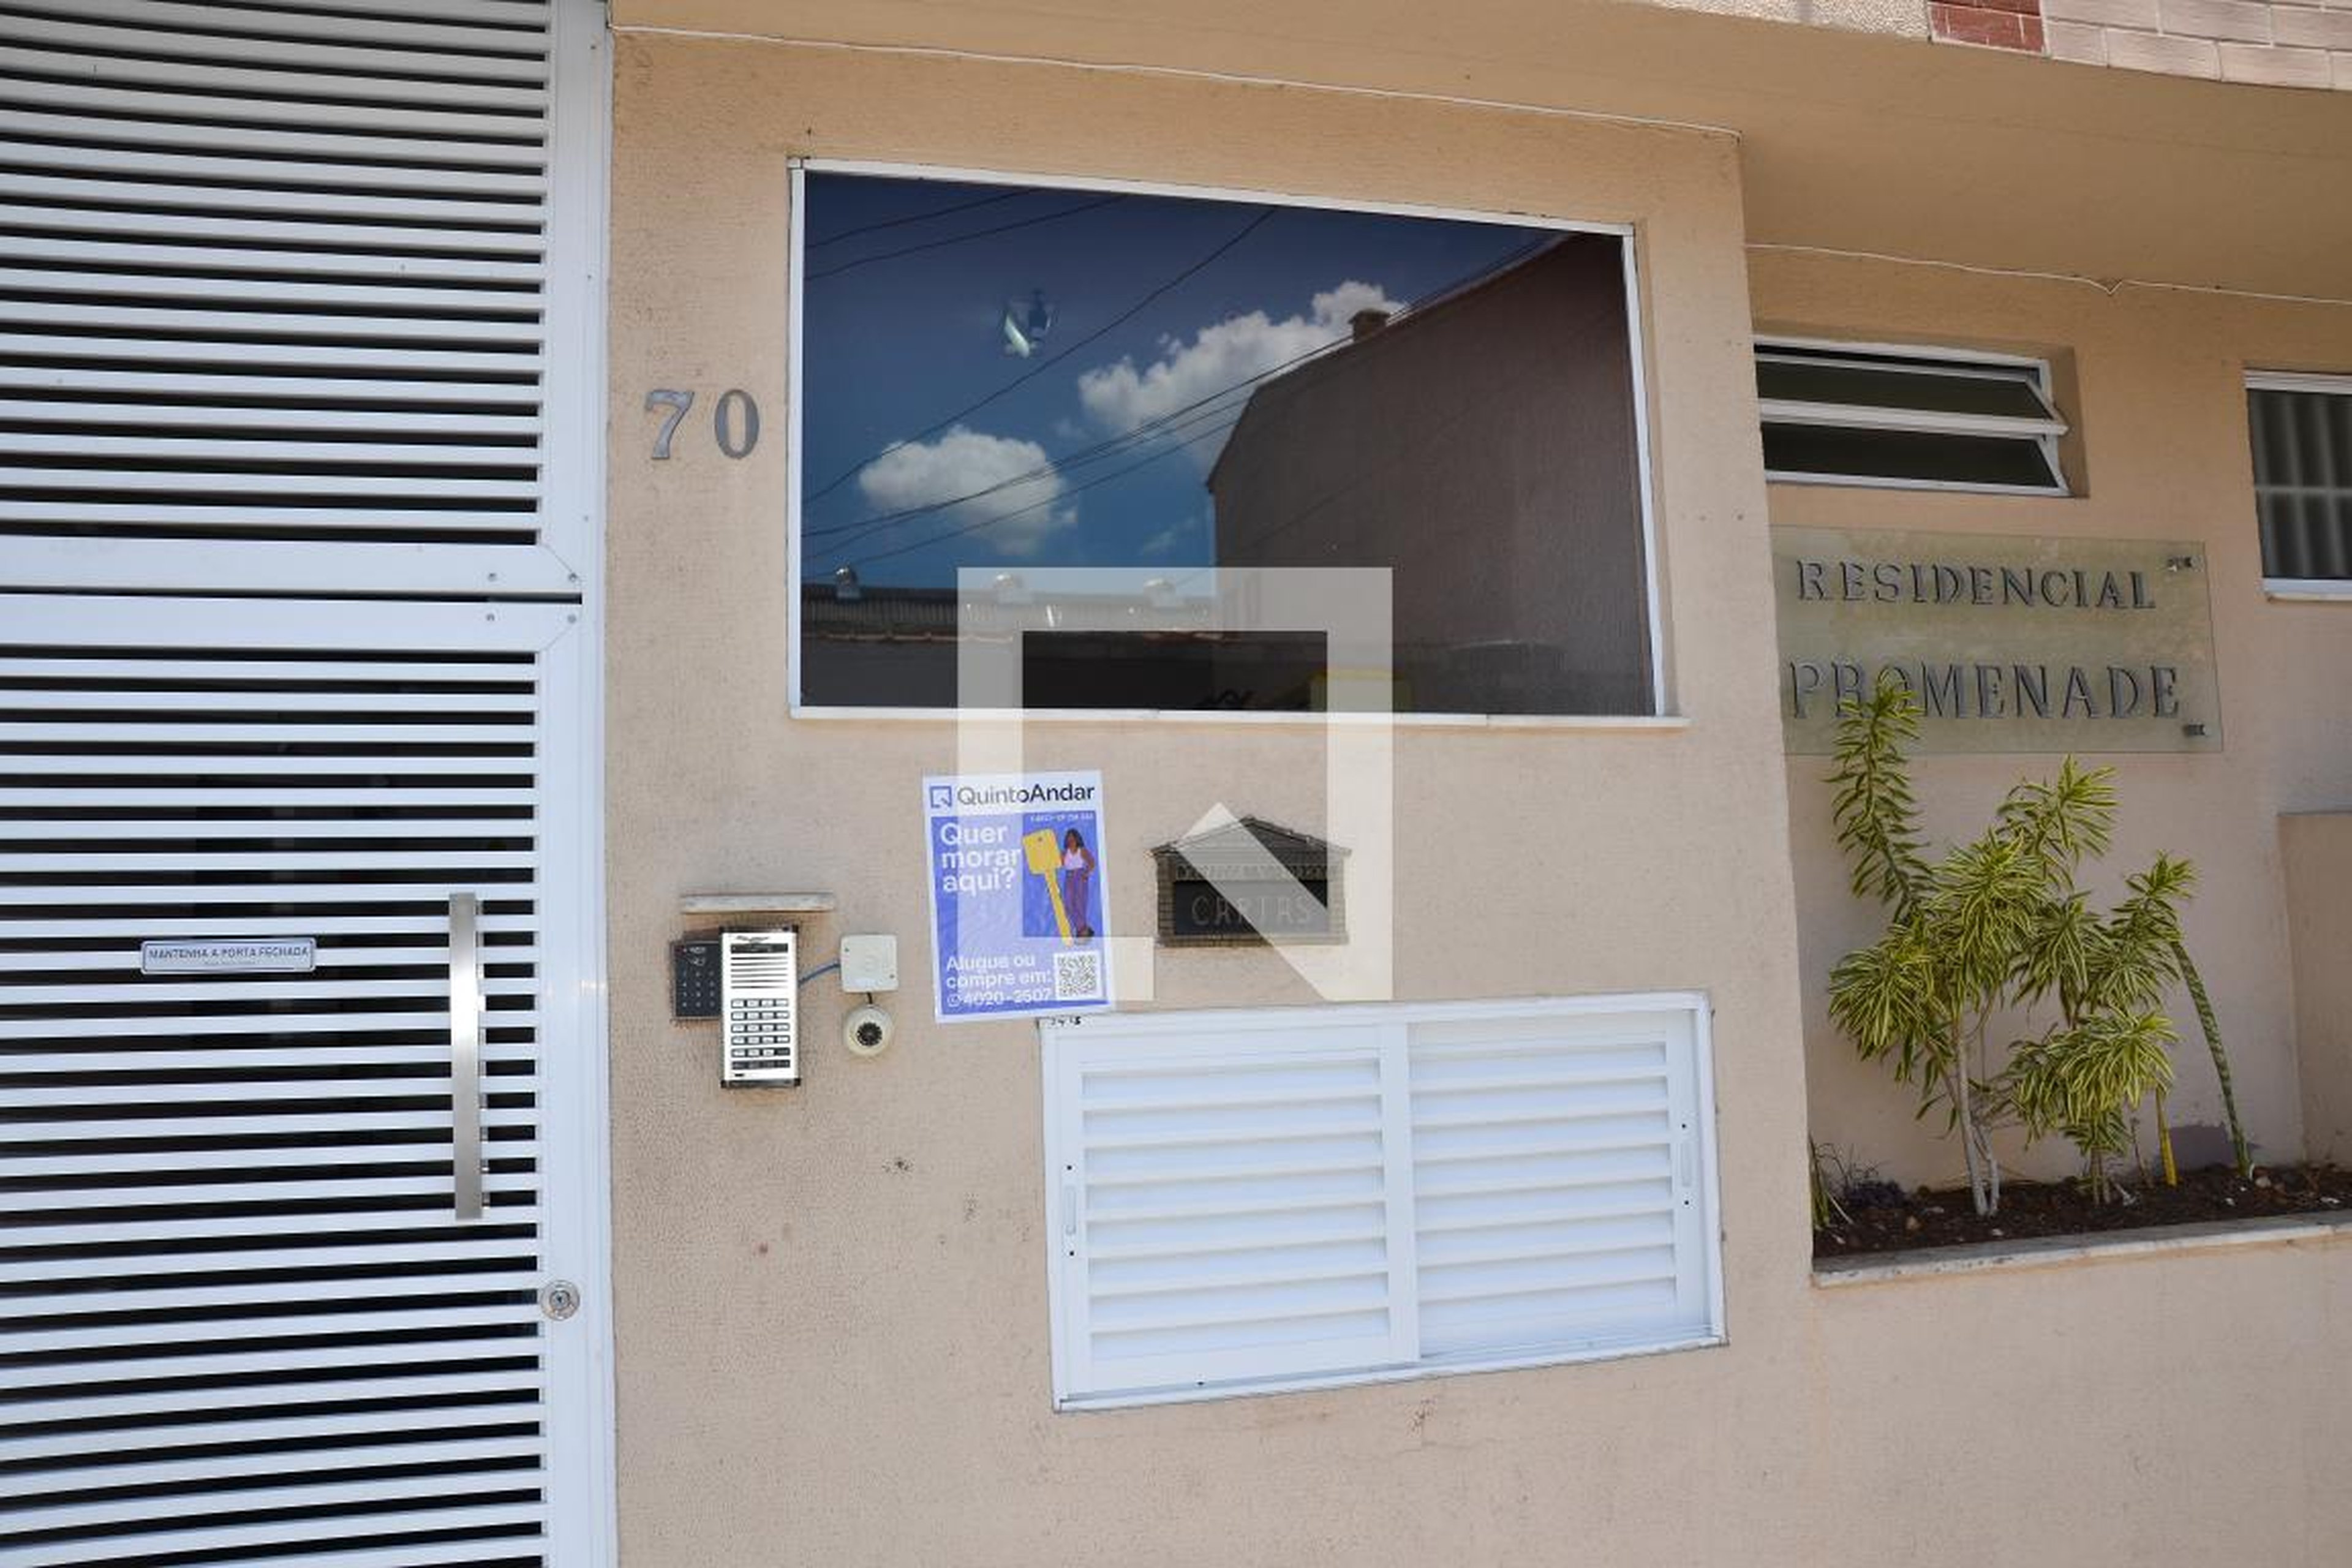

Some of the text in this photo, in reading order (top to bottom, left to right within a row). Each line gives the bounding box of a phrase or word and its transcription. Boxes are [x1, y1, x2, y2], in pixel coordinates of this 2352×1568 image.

[644, 388, 760, 460] 70
[1796, 559, 2155, 609] RESIDENCIAL
[957, 783, 1095, 805] QuintoAndar
[940, 823, 1008, 846] Quer
[941, 848, 1021, 869] morar
[943, 868, 1016, 896] aqui?
[149, 946, 309, 959] MANTENHA A PORTA FECHADA
[946, 955, 1035, 974] Alugue ou
[946, 973, 1015, 989] compre
